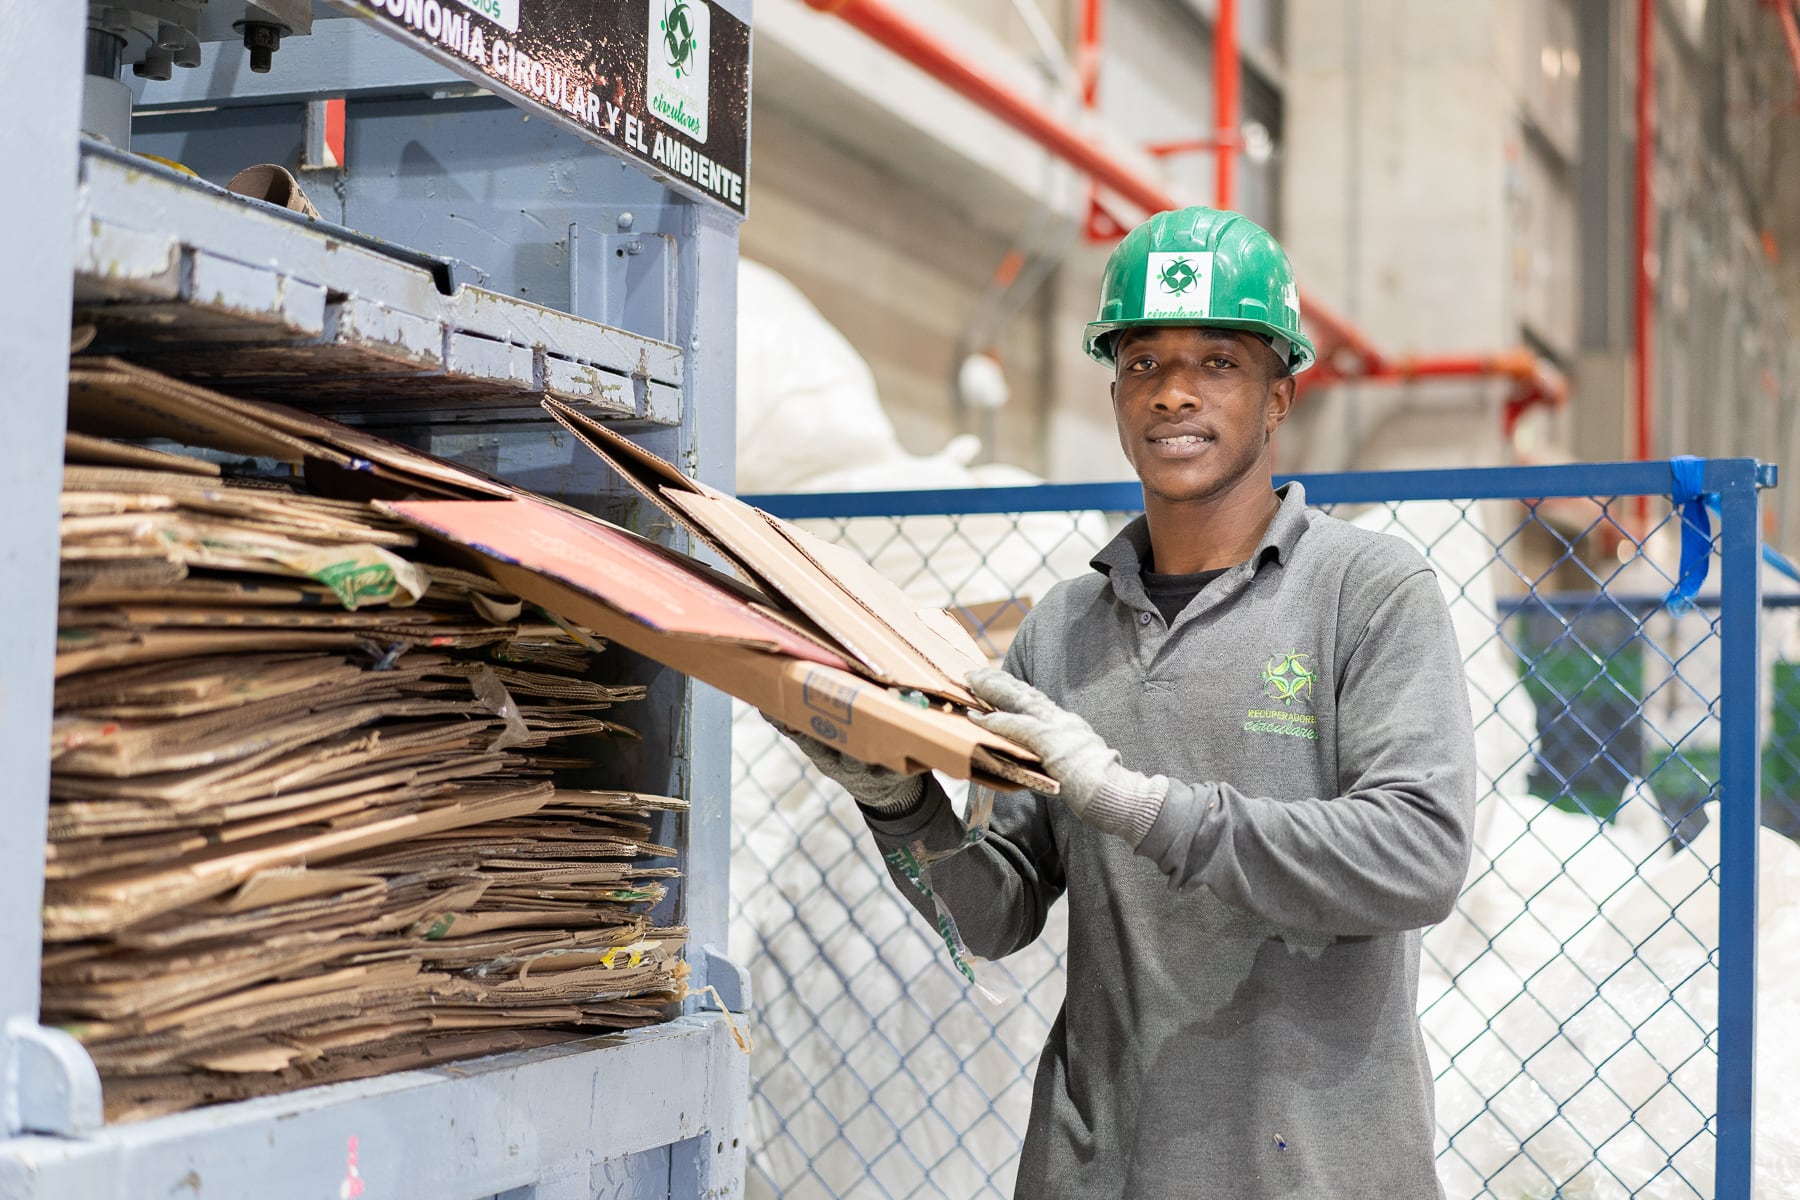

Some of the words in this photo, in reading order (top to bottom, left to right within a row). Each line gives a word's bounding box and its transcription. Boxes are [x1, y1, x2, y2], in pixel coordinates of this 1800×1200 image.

[369, 0, 487, 66] NOMÍA
[492, 39, 600, 128] CIRCULAR
[606, 101, 620, 136] Y
[625, 113, 648, 155] EL
[652, 131, 742, 206] AMBIENTE
